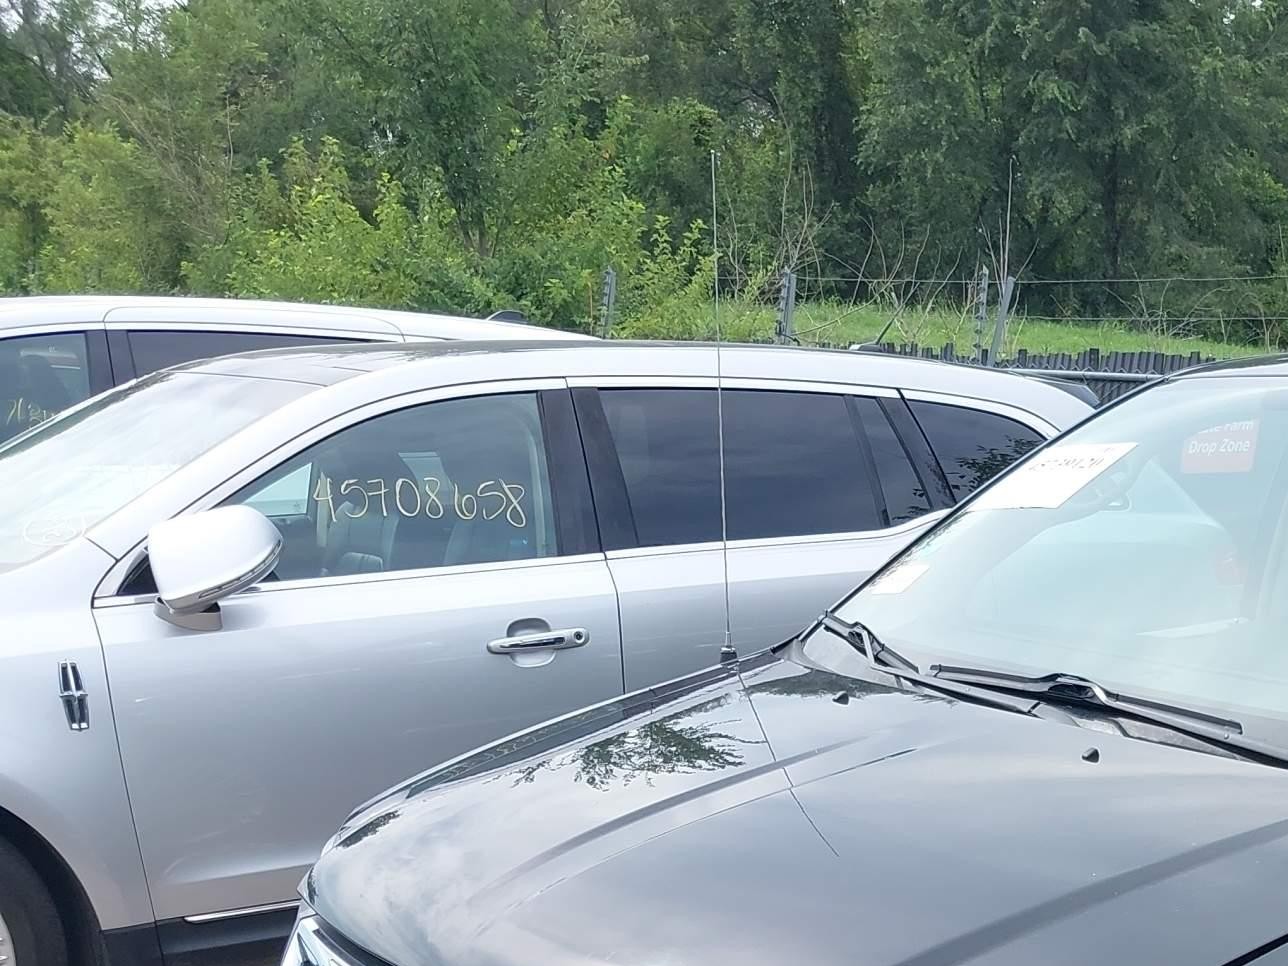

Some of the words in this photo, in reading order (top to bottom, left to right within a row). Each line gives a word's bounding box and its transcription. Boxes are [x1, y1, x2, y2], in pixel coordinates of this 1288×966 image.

[1188, 440, 1217, 456] Drop
[1218, 438, 1250, 453] Zone
[313, 477, 527, 528] 45708658
